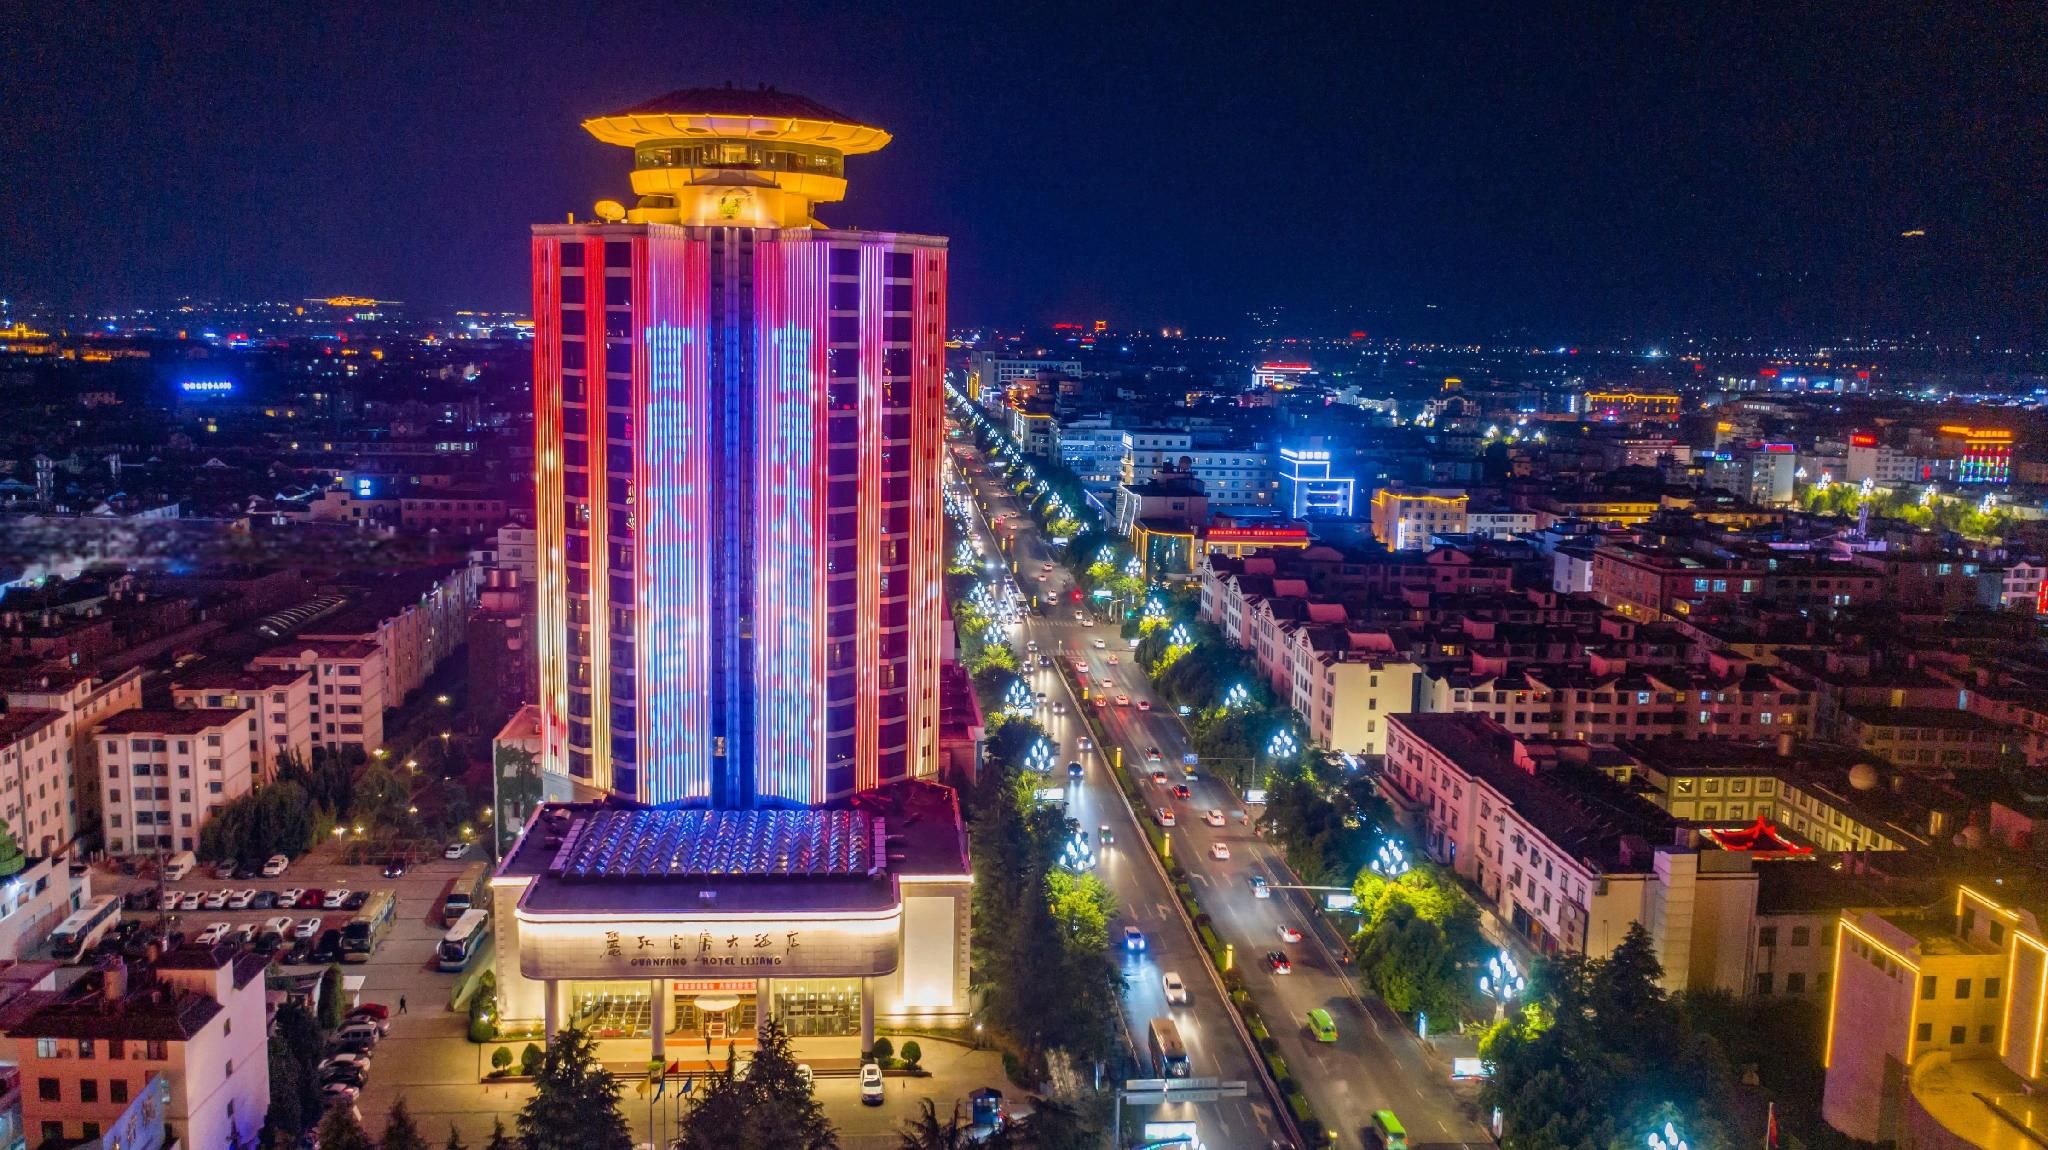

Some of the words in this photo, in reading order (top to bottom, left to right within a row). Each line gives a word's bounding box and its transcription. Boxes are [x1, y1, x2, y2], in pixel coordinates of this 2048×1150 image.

[630, 957, 688, 967] GUANFANG
[702, 956, 736, 966] HOTEL
[740, 956, 782, 966] LIJIANG
